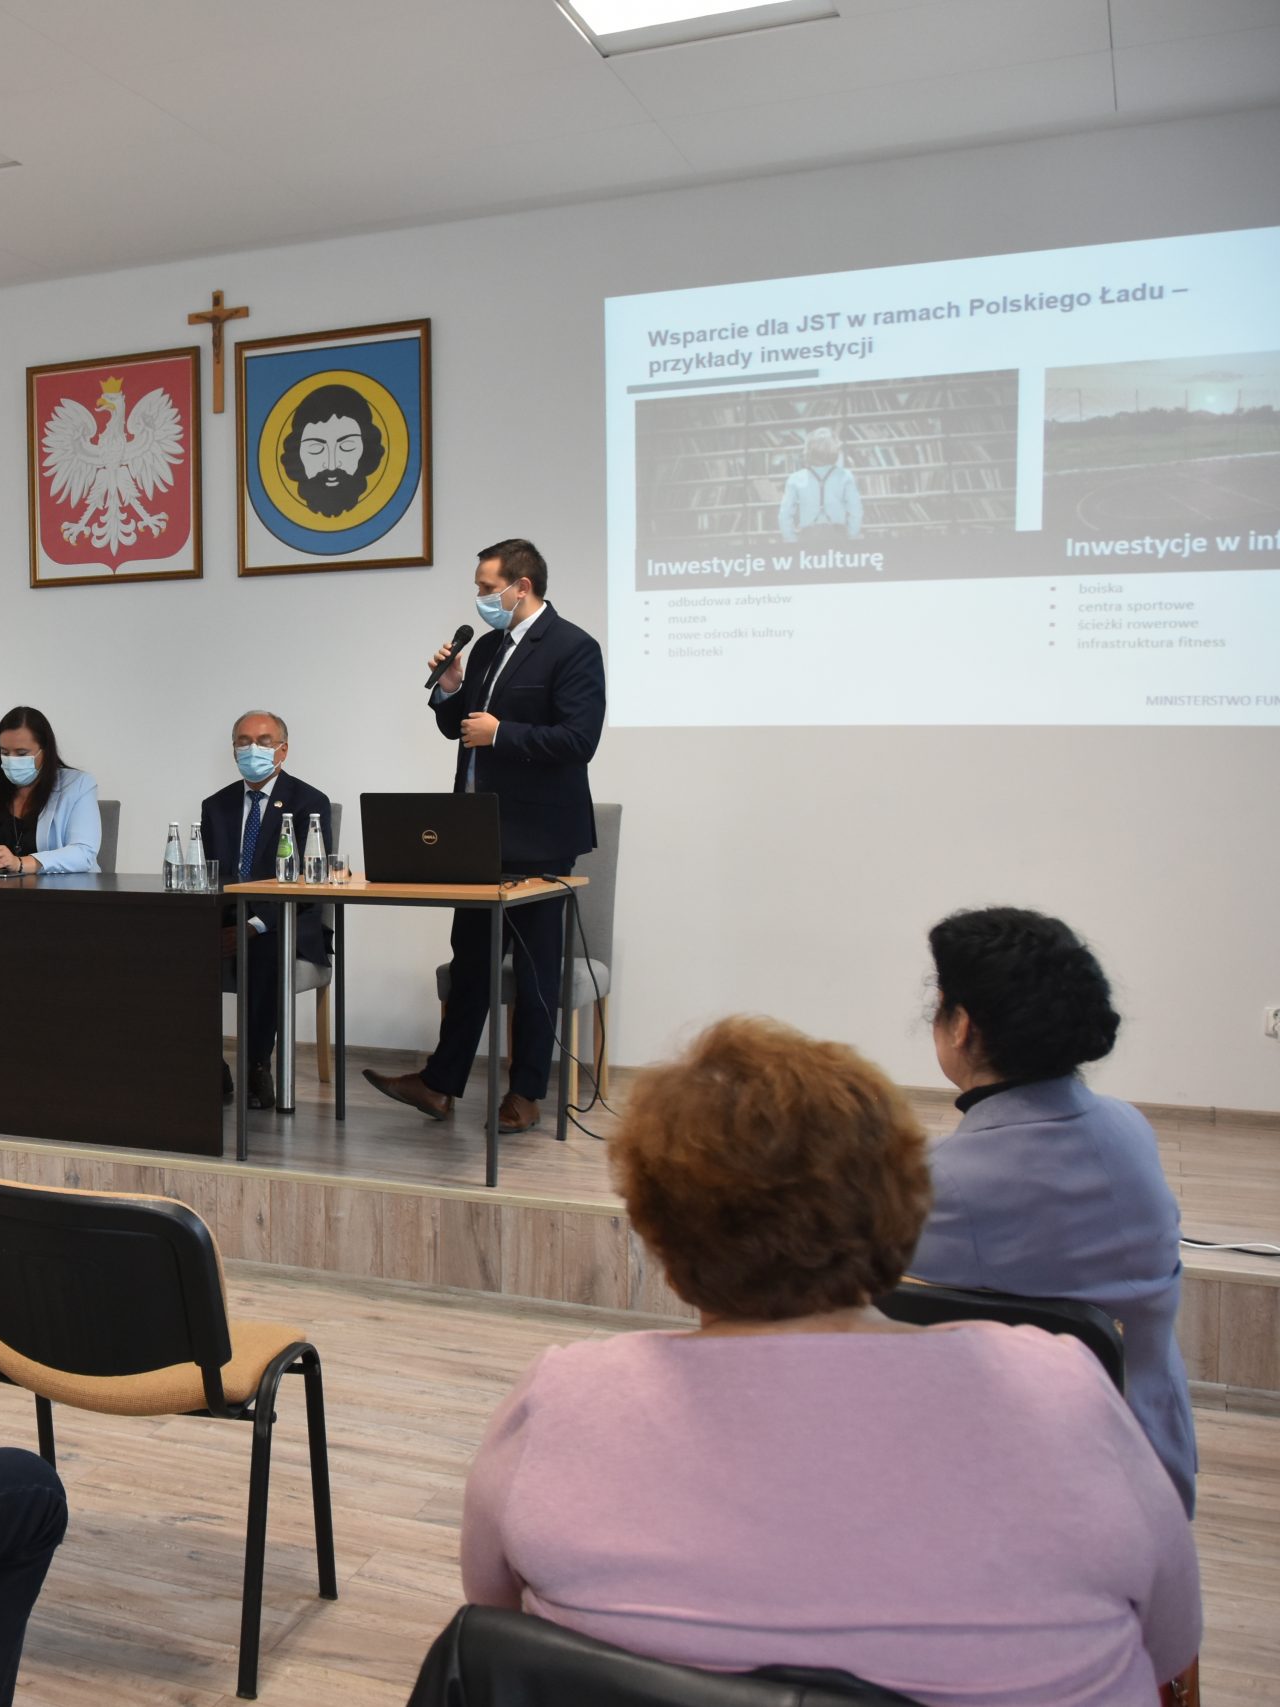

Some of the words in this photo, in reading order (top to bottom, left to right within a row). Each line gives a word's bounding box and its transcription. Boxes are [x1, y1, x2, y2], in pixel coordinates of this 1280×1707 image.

[648, 322, 749, 348] Wsparcie
[756, 319, 789, 337] dla
[797, 312, 841, 333] JST
[847, 314, 867, 328] w
[873, 301, 961, 326] ramach
[969, 292, 1092, 316] Polskiego
[1099, 283, 1164, 305] Ładu
[649, 350, 752, 377] przykłady
[760, 337, 874, 363] inwestycji
[1066, 533, 1207, 558] Inwestycje
[1216, 536, 1240, 551] w
[647, 554, 766, 577] Inwestycje
[772, 556, 792, 570] w
[800, 549, 884, 571] kulturę
[1079, 583, 1123, 594] boiska
[668, 595, 731, 608] odbudowa
[735, 593, 792, 606] zabytków
[1078, 603, 1122, 612] centra
[1127, 600, 1195, 613] sportowe
[668, 614, 707, 624] muzea
[1078, 618, 1122, 630] ścieżki
[1127, 619, 1199, 630] rowerowe
[668, 631, 700, 640] nowe
[704, 628, 748, 640] ośrodki
[751, 627, 794, 639] kultury
[1077, 637, 1174, 649] infrastruktura
[1178, 637, 1226, 648] fitness
[668, 646, 723, 658] biblioteki
[1146, 695, 1251, 706] MINISTERSTWO
